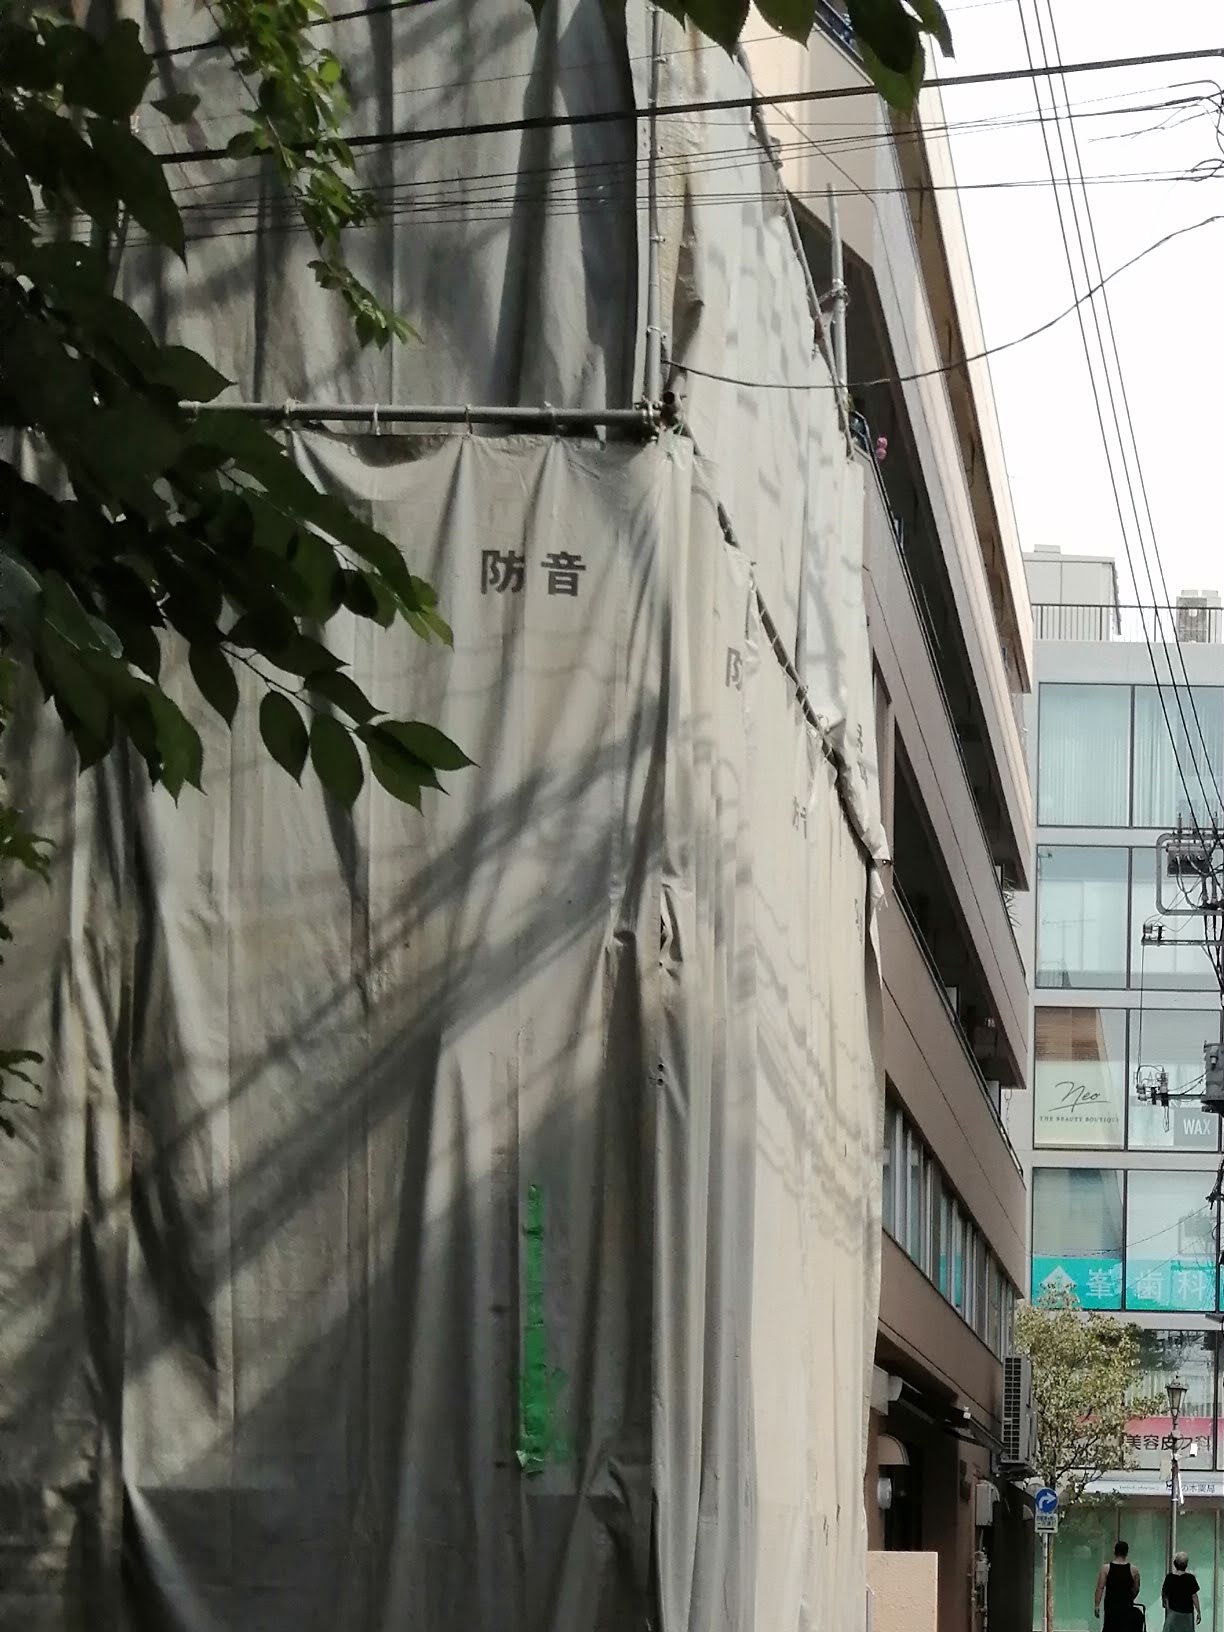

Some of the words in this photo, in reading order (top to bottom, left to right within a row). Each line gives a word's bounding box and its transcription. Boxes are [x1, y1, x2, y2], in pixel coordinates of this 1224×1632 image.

[480, 550, 587, 597] 防音
[1054, 1081, 1102, 1113] Neo
[1183, 1118, 1211, 1136] WAX
